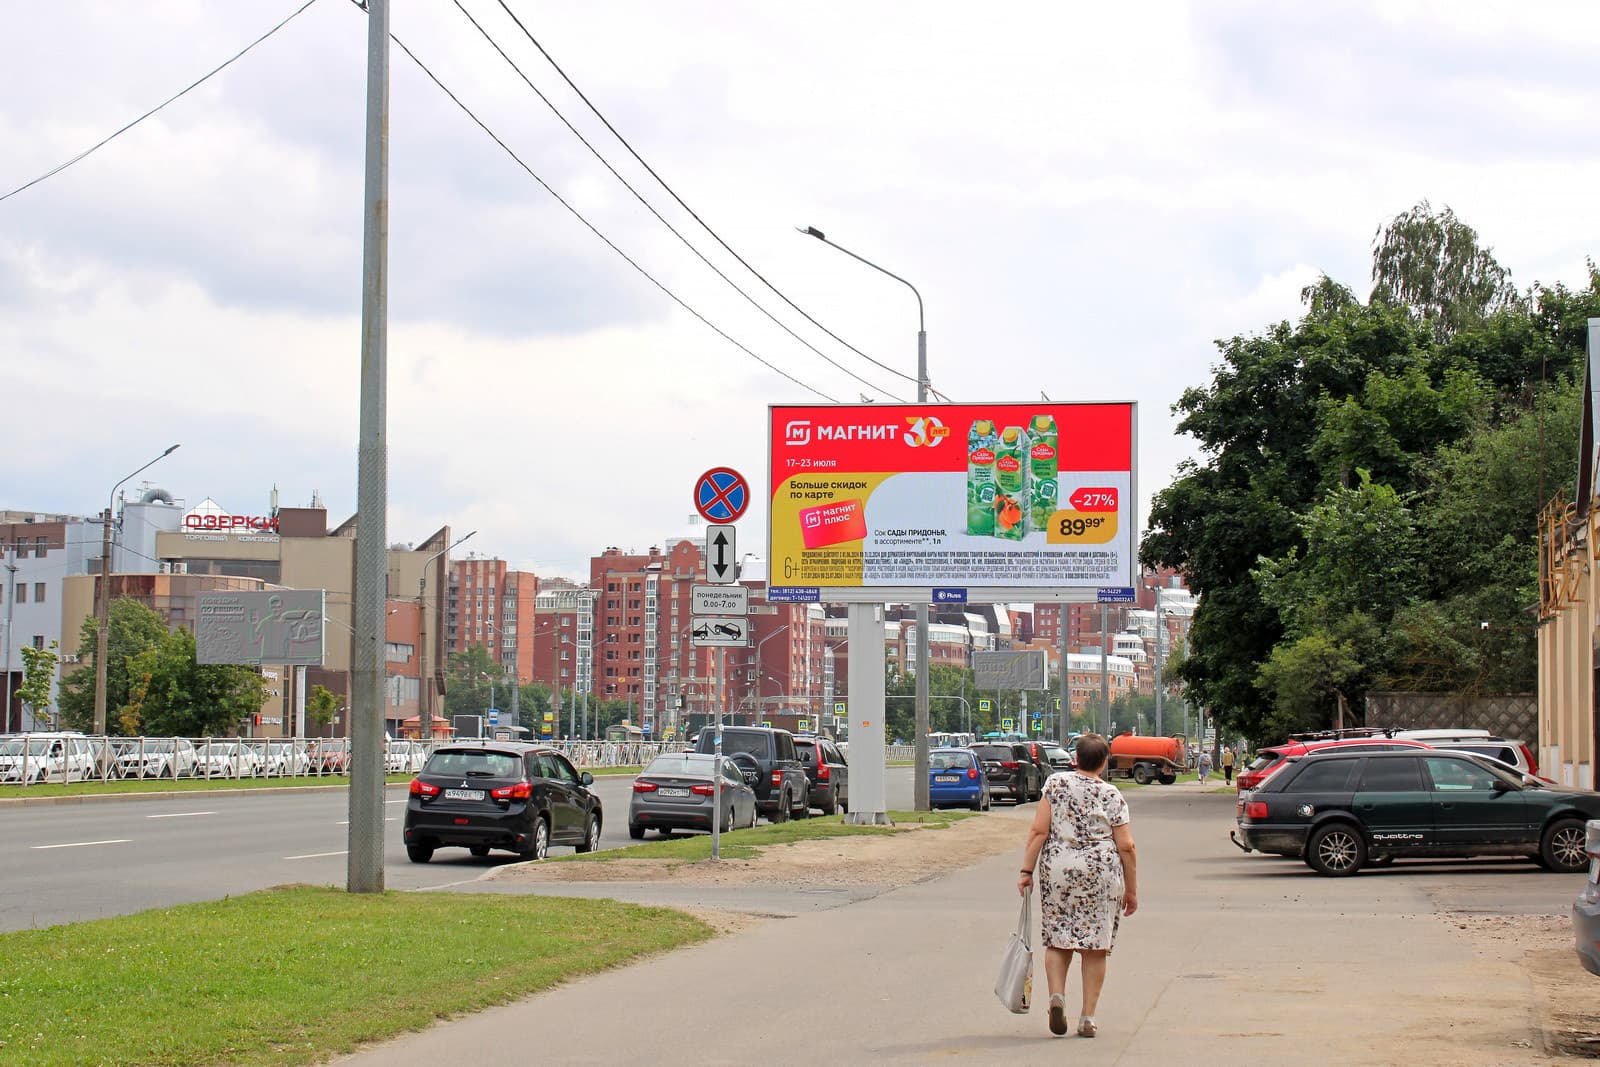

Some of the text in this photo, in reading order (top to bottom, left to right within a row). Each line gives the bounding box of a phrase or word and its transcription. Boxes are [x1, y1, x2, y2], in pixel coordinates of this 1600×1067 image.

[817, 425, 899, 441] МАГНИТ
[904, 416, 944, 447] 30
[813, 459, 837, 467] июля
[790, 481, 867, 490] Больше скидок
[790, 491, 803, 499] по
[823, 503, 856, 517] магнит
[186, 514, 279, 529] ОЗЕРКИ
[824, 514, 850, 525] плюс
[887, 529, 907, 537] САДЫ
[784, 556, 800, 579] 6+
